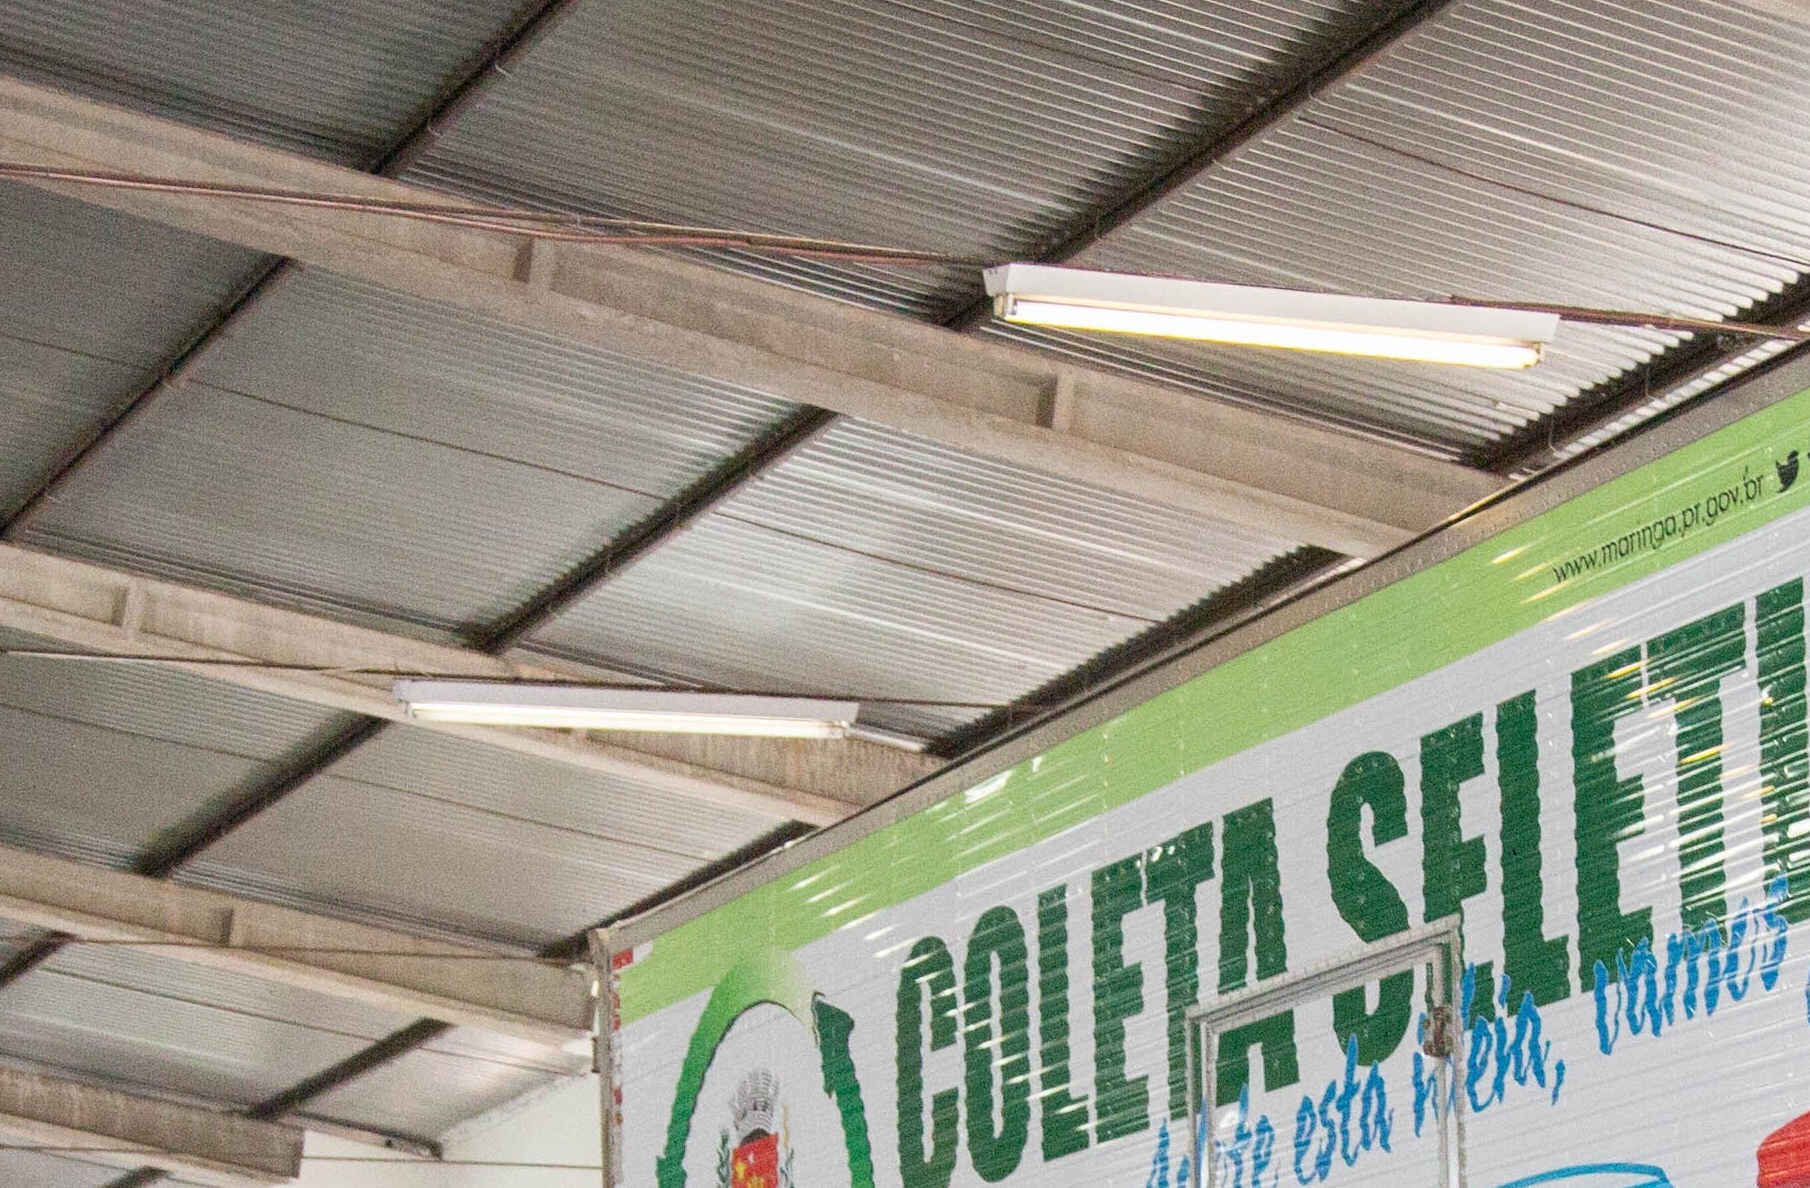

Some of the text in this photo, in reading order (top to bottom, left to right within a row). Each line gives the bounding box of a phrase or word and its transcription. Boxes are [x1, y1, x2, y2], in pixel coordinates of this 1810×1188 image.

[1553, 465, 1765, 583] www.maringa.pr.gov.br
[1293, 1032, 1394, 1186] esta
[1593, 871, 1789, 1056] vamos
